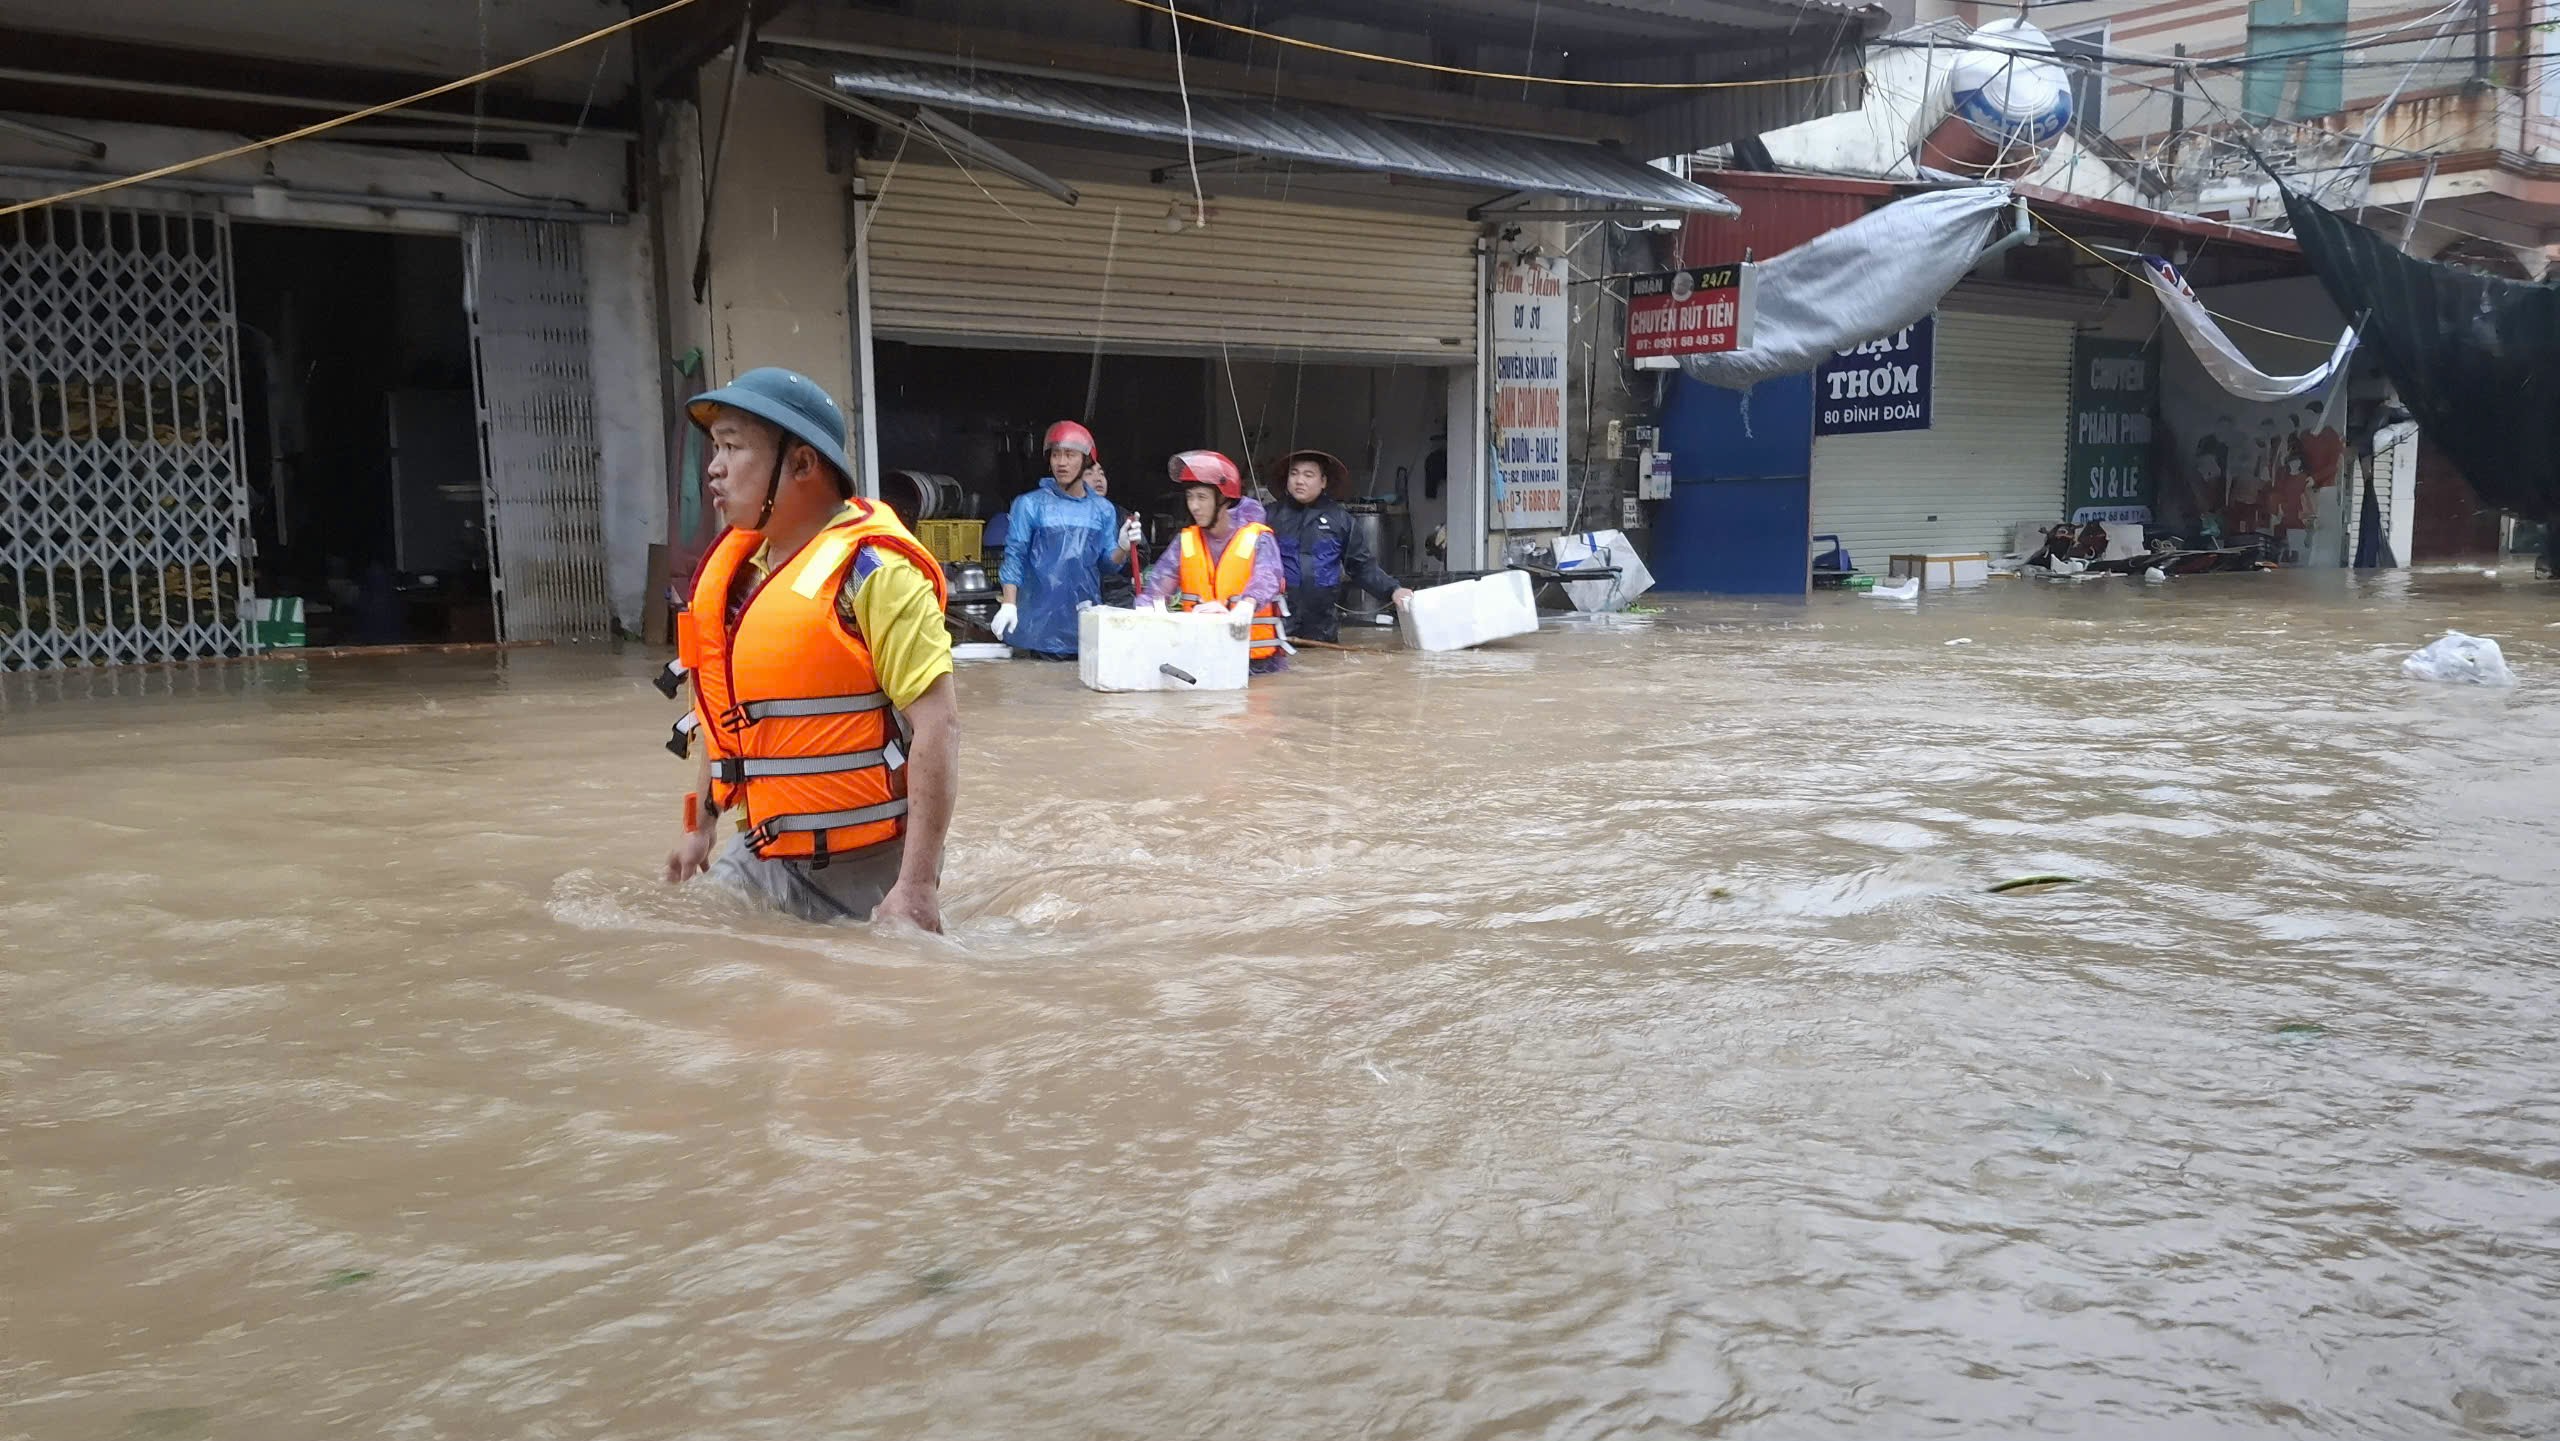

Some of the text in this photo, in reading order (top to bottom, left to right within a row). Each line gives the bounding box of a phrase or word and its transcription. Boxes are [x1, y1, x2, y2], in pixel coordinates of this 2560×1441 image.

[1701, 270, 1732, 288] 24/7
[1514, 304, 1524, 329] CƠ
[1631, 294, 1735, 335] CHUYỂN RÚT TIỀN
[1654, 337, 1677, 349] 0931
[1696, 334, 1709, 346] 49
[1711, 333, 1725, 345] 53
[1497, 347, 1557, 379] CHUYÊN SẢN XUẤT
[1827, 361, 1919, 400] THƠM
[1824, 401, 1920, 424] 80 ĐÌNH ĐOÀI
[2078, 406, 2117, 444] PHÂN
[1512, 432, 1530, 463] BUÔN
[1536, 431, 1550, 463] BÁN
[1521, 466, 1540, 483] ĐÌNH
[2090, 456, 2139, 499] SỈ & LẺ
